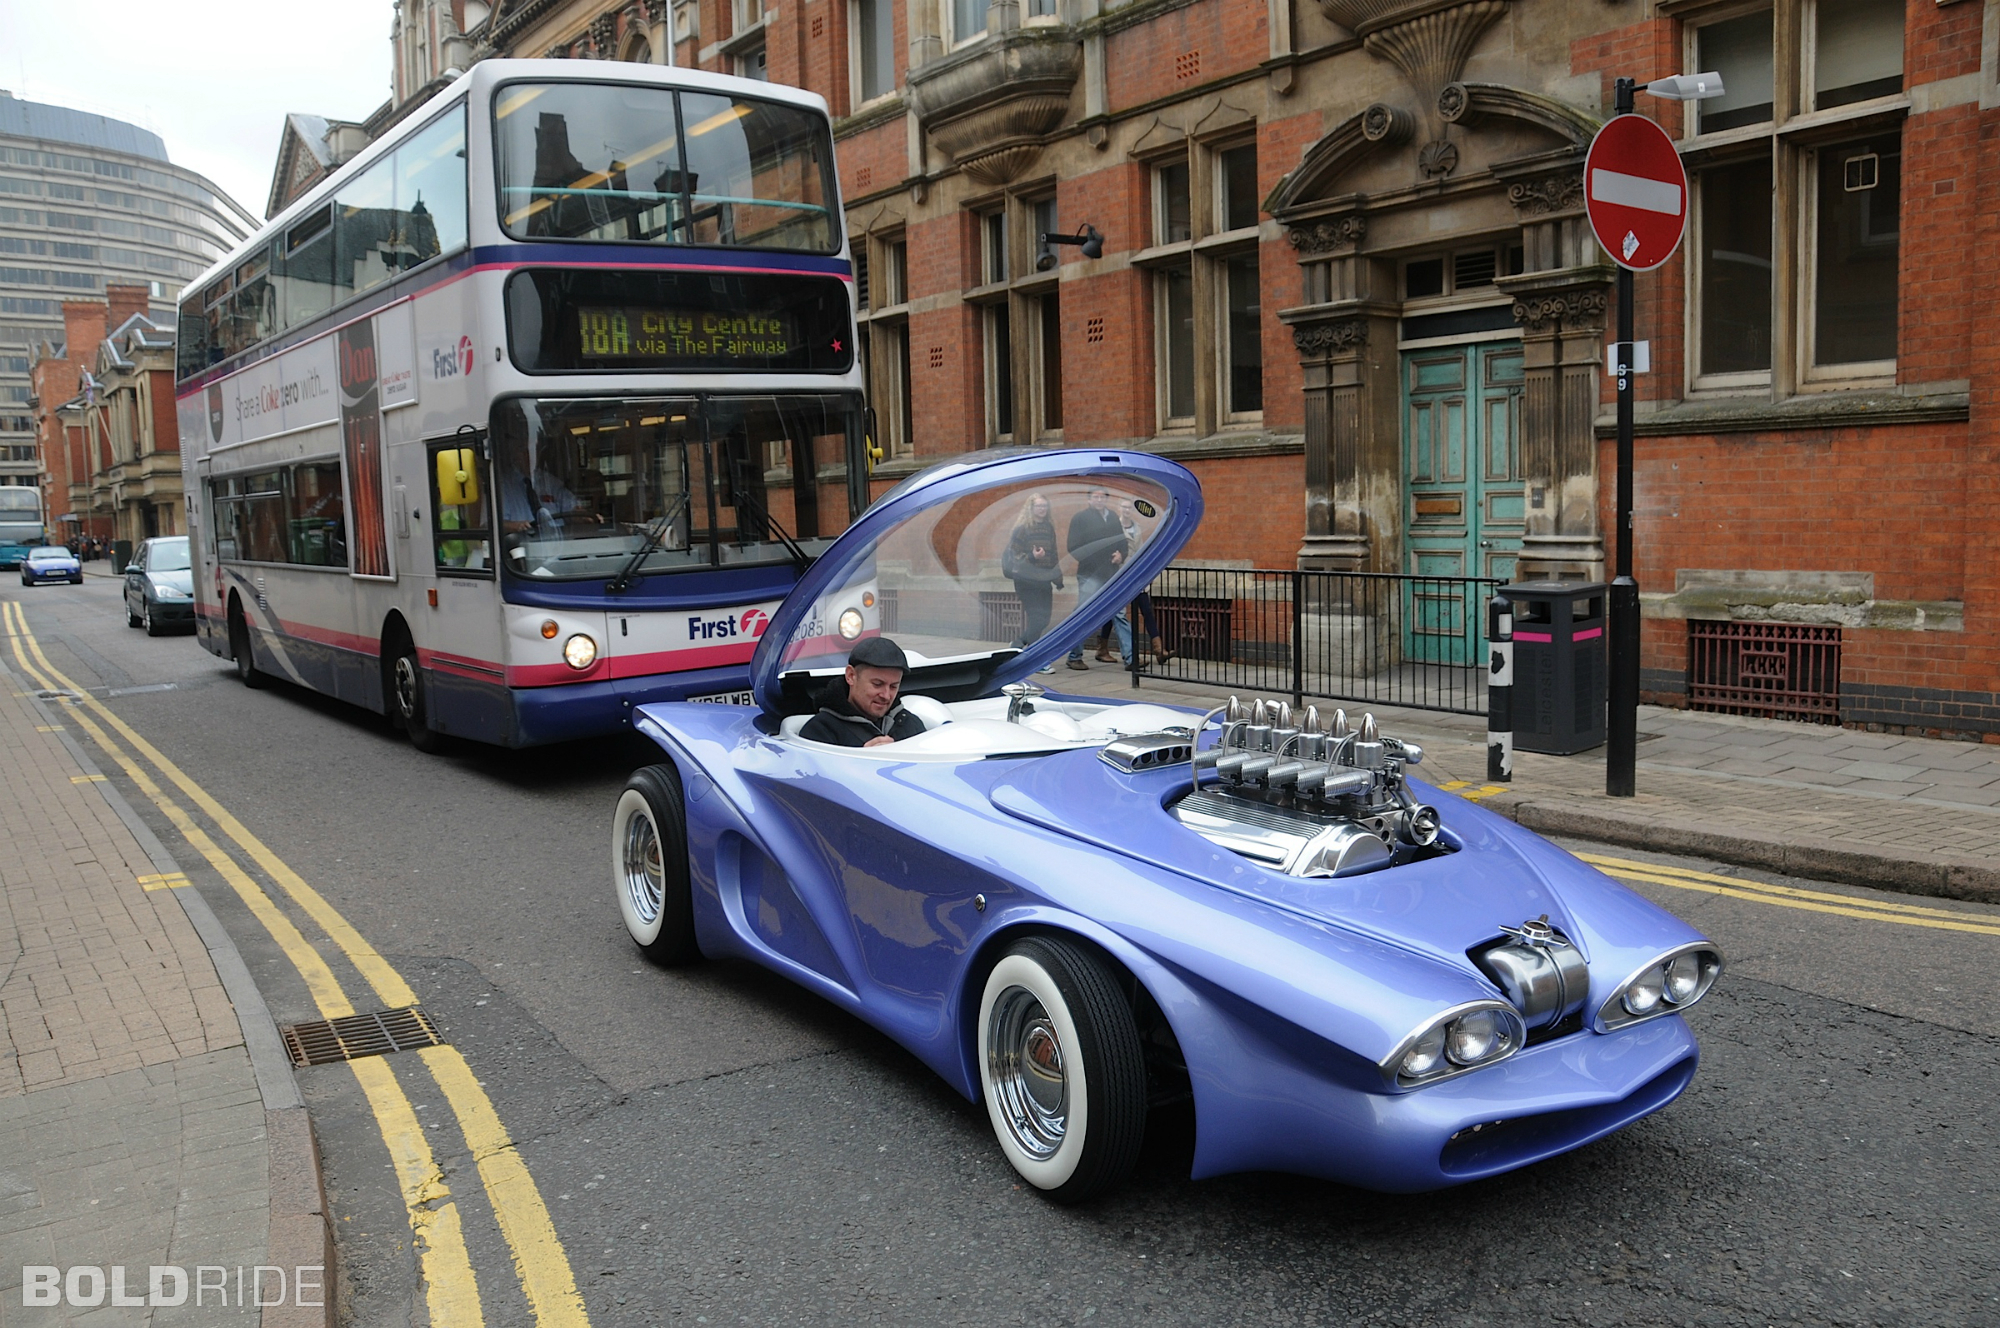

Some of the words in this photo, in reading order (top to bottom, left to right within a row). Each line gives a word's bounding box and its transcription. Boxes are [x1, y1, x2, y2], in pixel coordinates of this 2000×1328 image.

[642, 310, 693, 334] City
[702, 310, 781, 335] Centre
[433, 344, 458, 380] First
[636, 336, 666, 354] via
[671, 336, 708, 354] The
[712, 335, 787, 354] Fairway
[339, 338, 377, 388] Dan
[235, 396, 255, 421] Share
[255, 395, 260, 416] a
[260, 383, 279, 413] Coke
[280, 381, 299, 407] zero
[688, 615, 737, 640] First
[1538, 649, 1553, 735] Leicester
